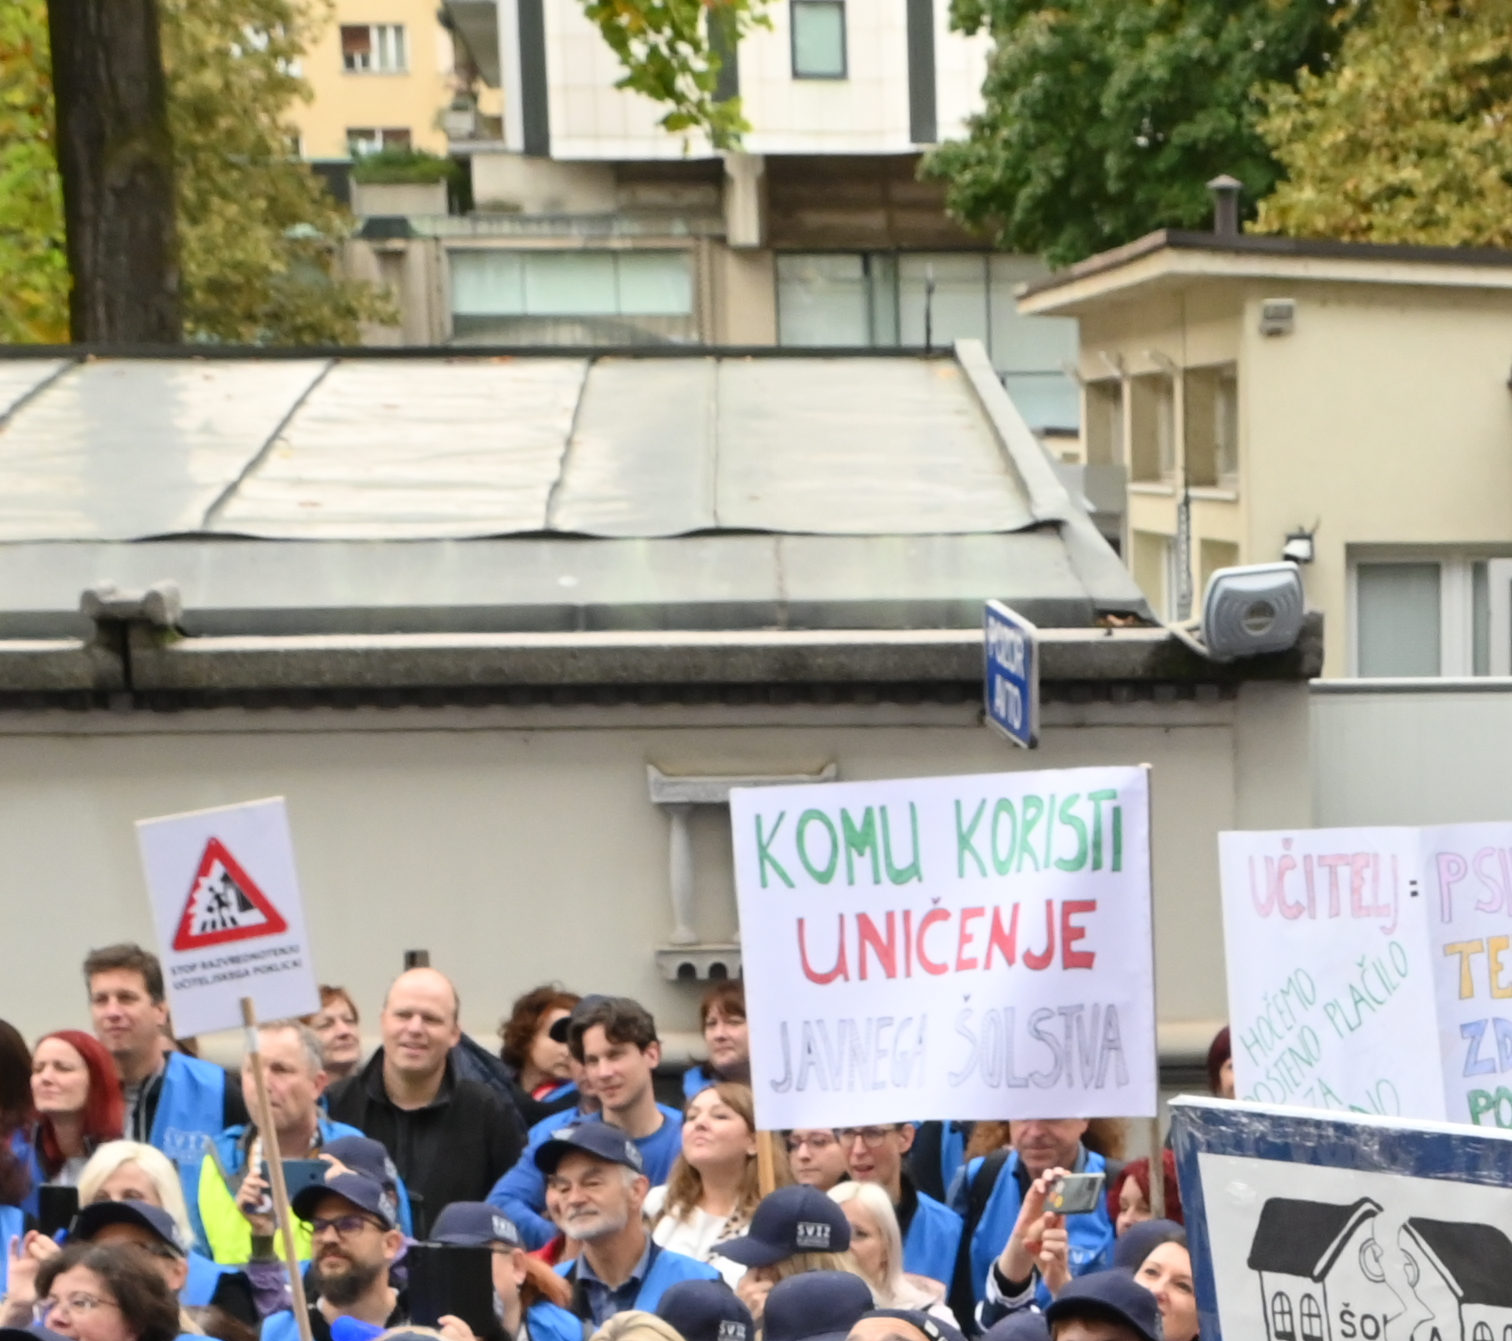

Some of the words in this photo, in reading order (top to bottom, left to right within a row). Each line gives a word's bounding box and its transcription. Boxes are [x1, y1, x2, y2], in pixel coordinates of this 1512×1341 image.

[755, 801, 923, 889] KOMU
[955, 788, 1122, 879] KORISTI
[797, 897, 1097, 985] UNIČENJE
[770, 1013, 926, 1093] JAVNEGA
[948, 994, 1129, 1089] ŠOLSTVA
